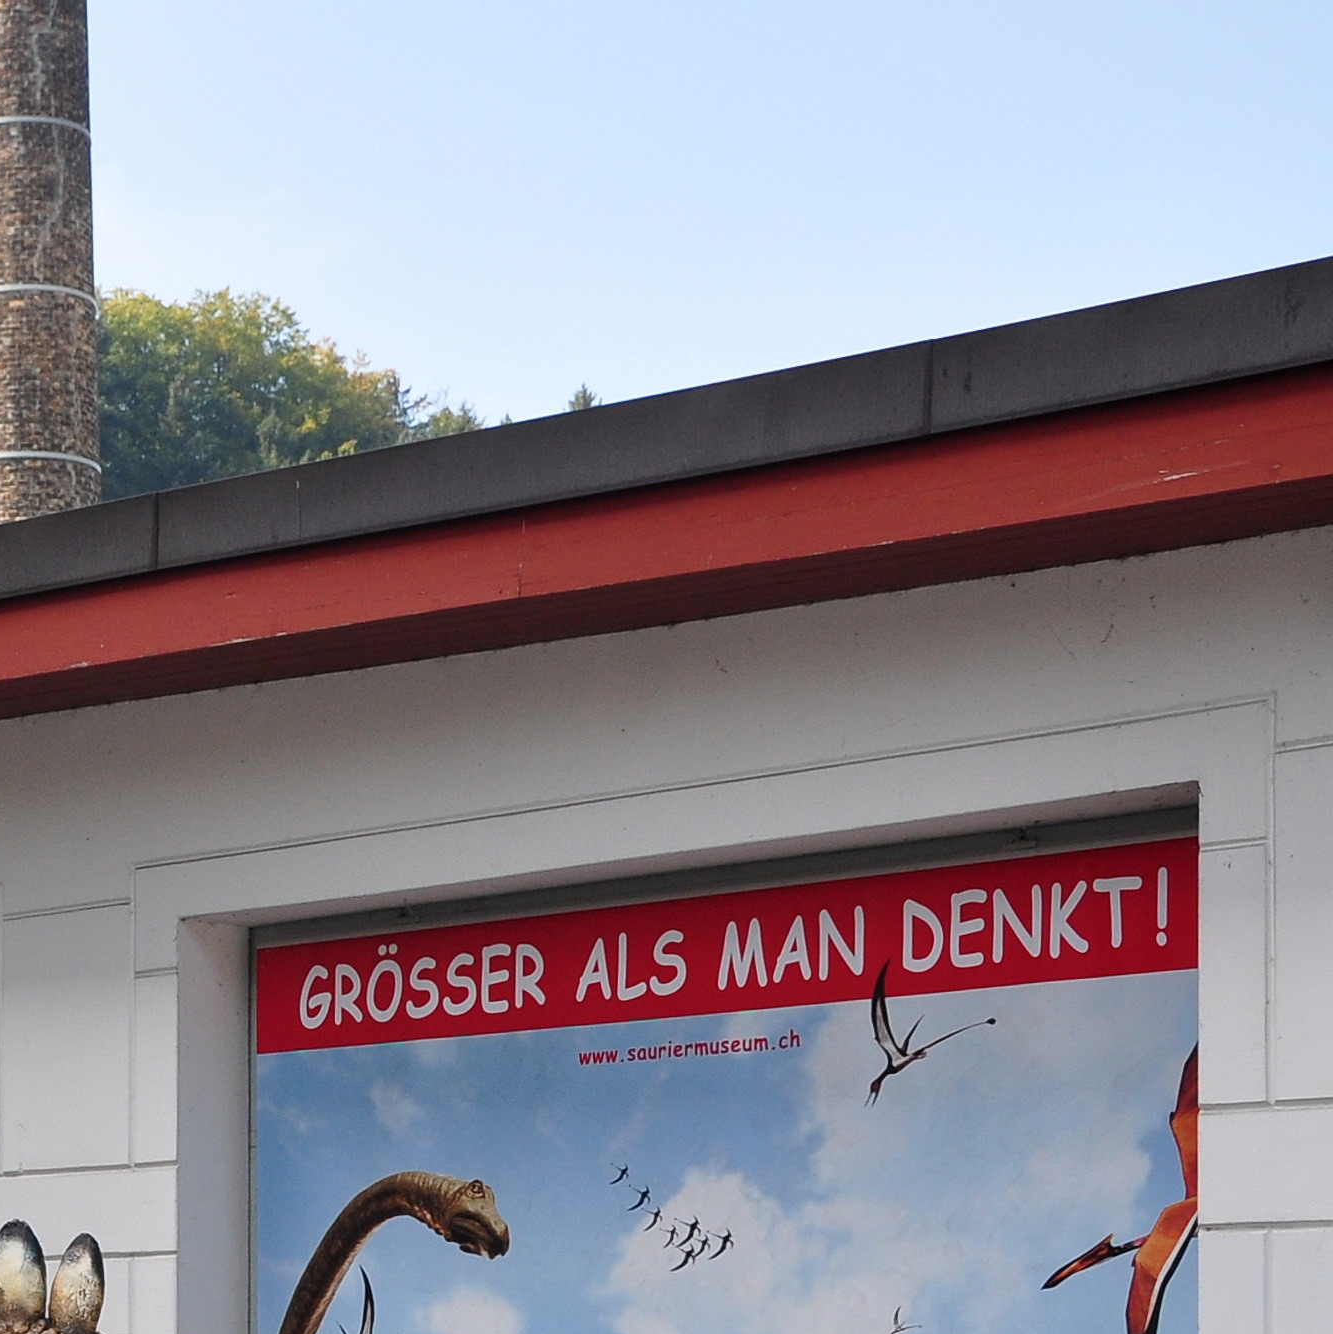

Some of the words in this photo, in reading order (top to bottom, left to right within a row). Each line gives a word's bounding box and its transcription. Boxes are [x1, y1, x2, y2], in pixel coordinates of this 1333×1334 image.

[299, 943, 546, 1030] GRÖSSER
[576, 929, 687, 1001] ALS
[717, 904, 864, 990] MAN
[902, 866, 1168, 972] DENKT!
[578, 1029, 801, 1066] www.sauriermuseum.ch
